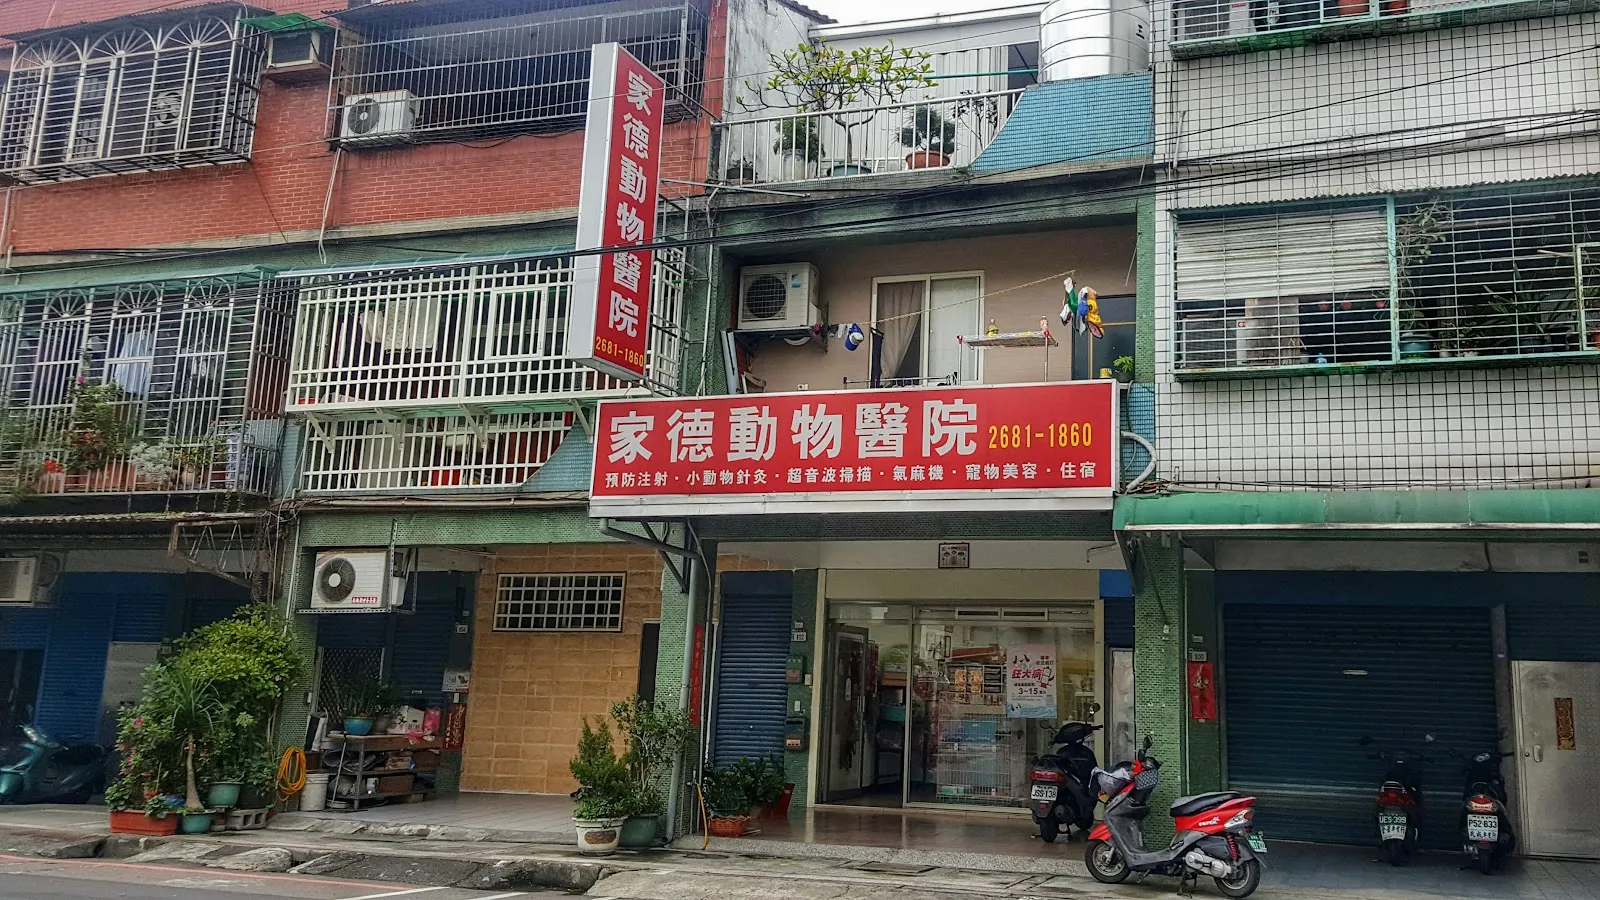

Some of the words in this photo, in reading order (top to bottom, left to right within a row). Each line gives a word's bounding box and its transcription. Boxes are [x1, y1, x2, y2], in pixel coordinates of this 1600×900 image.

[608, 70, 652, 337] 家德動物醫院
[596, 336, 644, 368] 2681-1860
[608, 398, 979, 464] 家德動物醫院
[988, 422, 1093, 449] 2681-1860
[605, 471, 668, 488] 預防注射
[686, 468, 768, 486] 小動物針灸
[787, 466, 872, 484] 超音波掃描
[892, 464, 944, 482] 氣麻機
[965, 463, 1038, 480] 寵物美容
[1060, 461, 1097, 479] 住宿
[1012, 669, 1042, 681] 狂犬病
